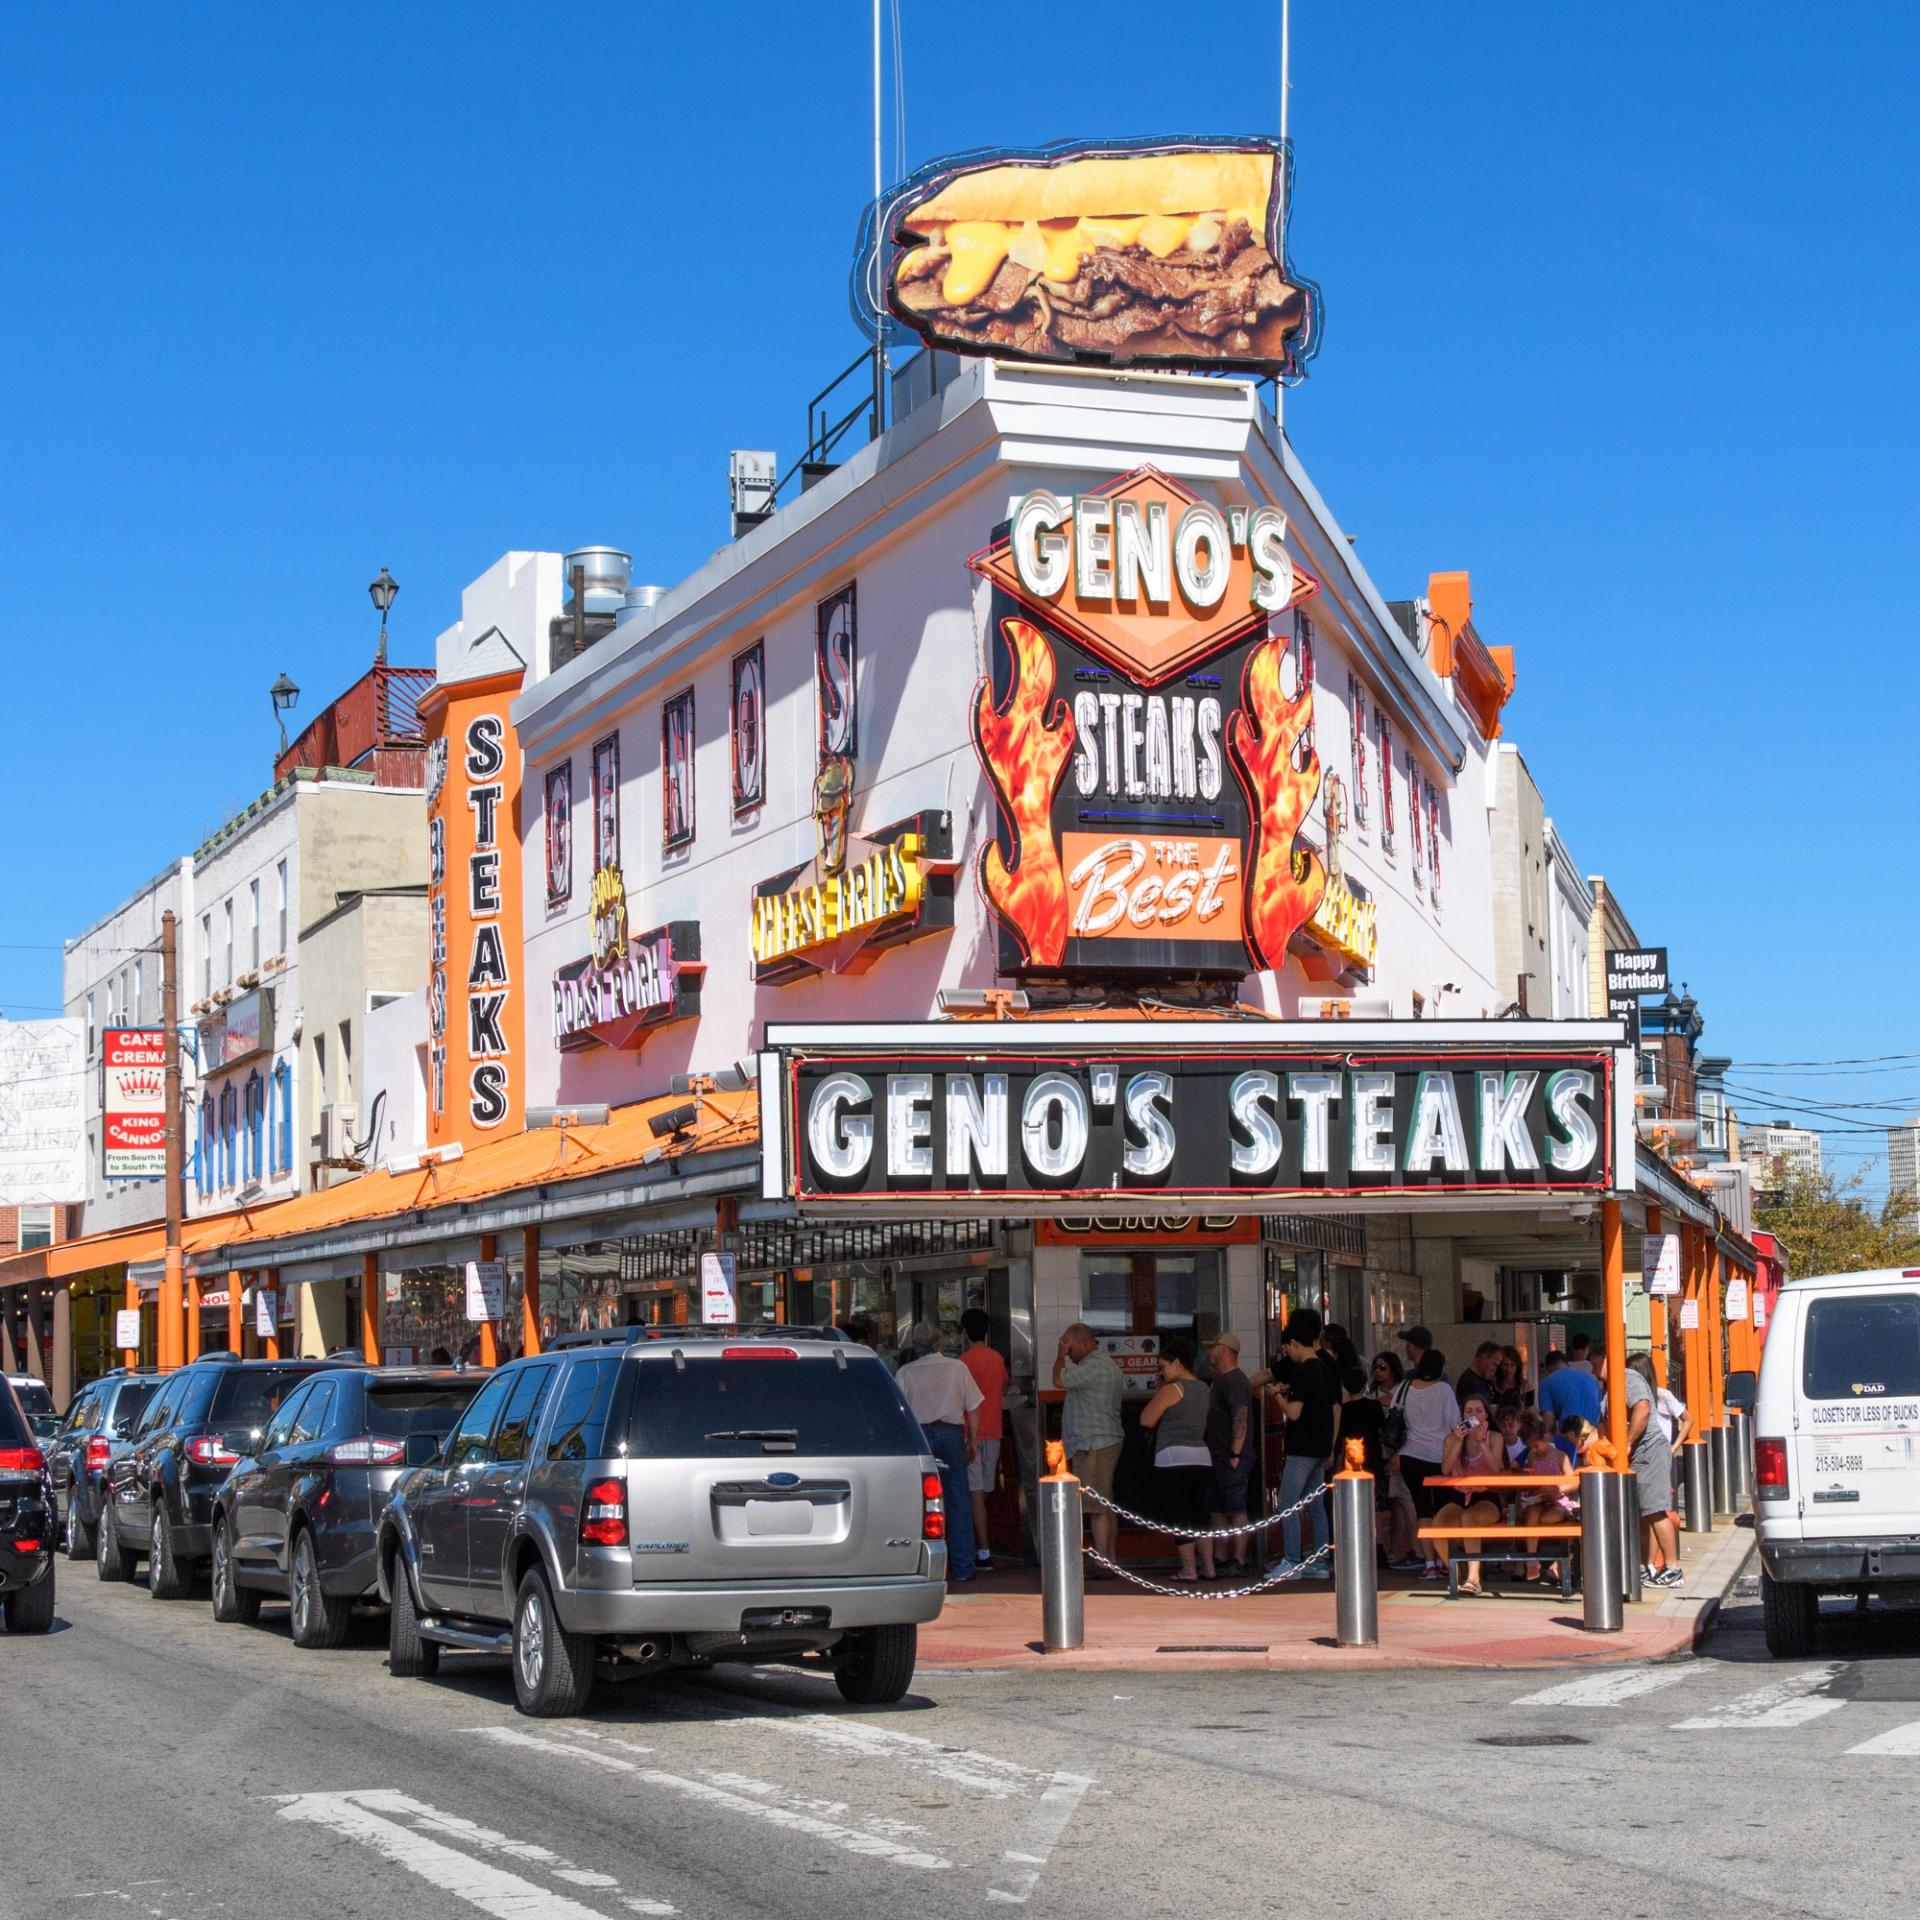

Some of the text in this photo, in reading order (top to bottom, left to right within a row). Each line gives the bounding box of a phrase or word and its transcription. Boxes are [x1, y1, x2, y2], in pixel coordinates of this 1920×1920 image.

[1011, 488, 1293, 612] GENO'S
[1074, 691, 1223, 800] STEAKS
[1151, 840, 1200, 864] THE
[1069, 838, 1239, 932] Best
[465, 714, 511, 1129] STEAKS
[1615, 953, 1657, 971] Happy
[1608, 972, 1665, 990] Birthday
[1610, 998, 1636, 1011] Ray's
[119, 1033, 164, 1046] CAFE
[122, 1117, 160, 1127] KING
[808, 1065, 1598, 1176] GENO'S STEAKS
[131, 1153, 156, 1161] South
[122, 1163, 147, 1171] South
[1127, 1357, 1158, 1367] GEAR
[1863, 1384, 1885, 1393] DAD
[1812, 1404, 1918, 1423] CLOSETS FOR LESS OF BUCKS
